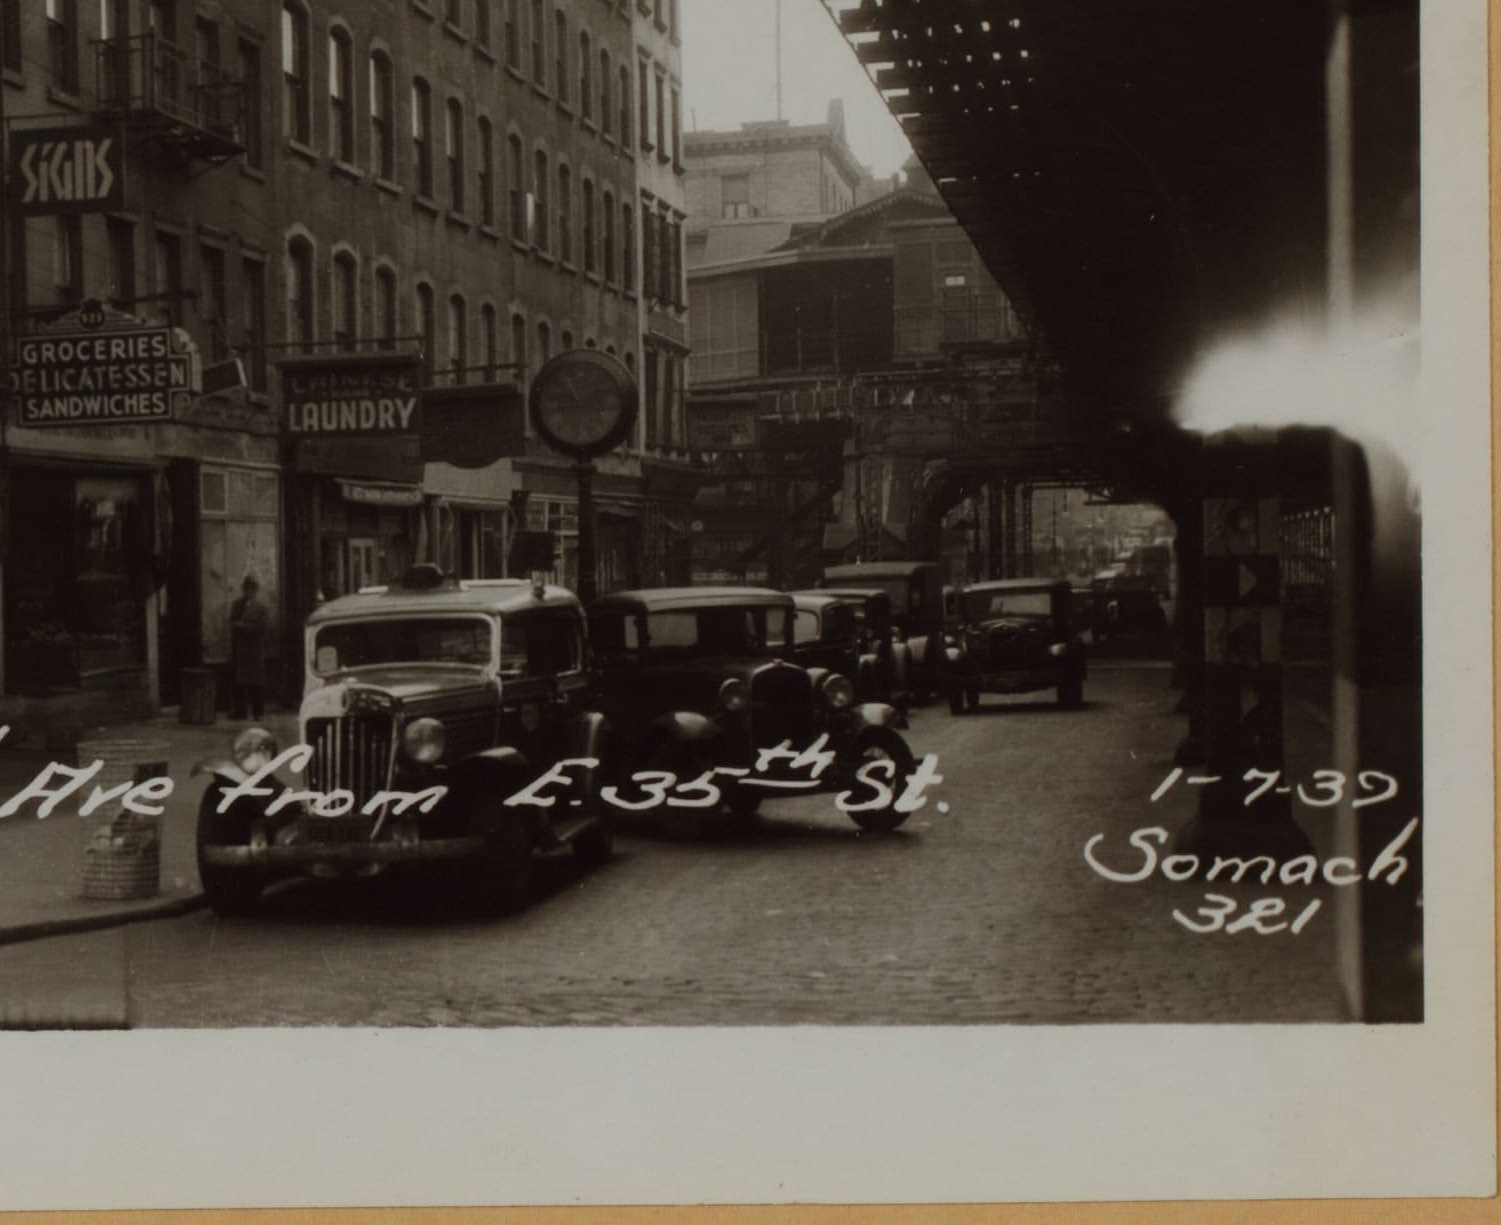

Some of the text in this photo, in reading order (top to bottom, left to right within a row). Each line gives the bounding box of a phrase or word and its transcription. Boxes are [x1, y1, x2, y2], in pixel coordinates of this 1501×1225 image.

[22, 335, 167, 365] GROCERIES
[26, 391, 166, 420] SANDWICHES
[288, 397, 418, 433] LAUNDRY
